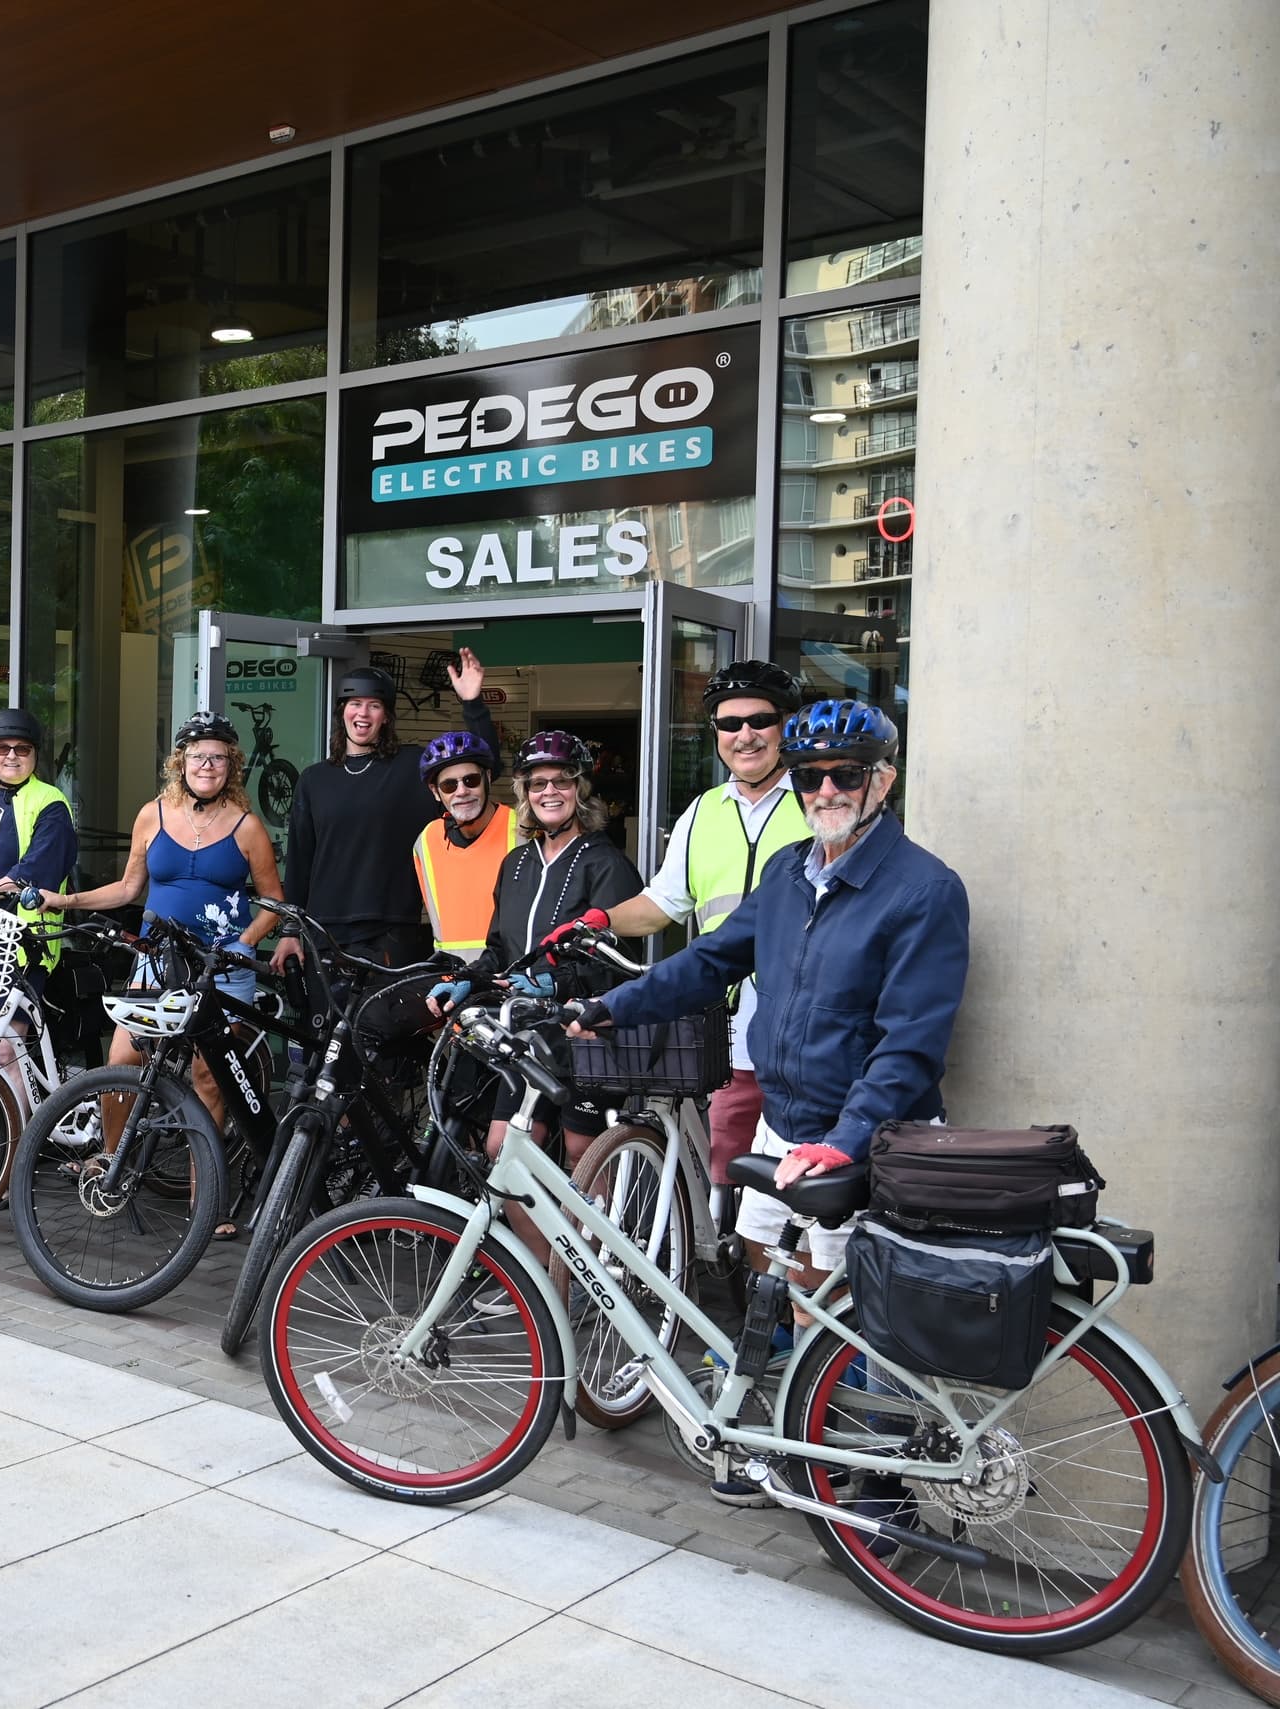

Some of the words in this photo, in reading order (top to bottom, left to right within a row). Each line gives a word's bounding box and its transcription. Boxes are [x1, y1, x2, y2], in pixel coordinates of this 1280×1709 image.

[372, 366, 715, 461] PEDEGO
[378, 455, 558, 495] ELECTRIC
[581, 437, 703, 472] BIKES
[425, 520, 649, 589] SALES
[226, 659, 297, 679] DEGO
[226, 682, 254, 692] TRIC
[481, 691, 500, 701] US
[24, 1060, 41, 1105] PEDEGO
[224, 1049, 261, 1115] PEDEGO
[554, 1234, 616, 1311] PEDEGO
